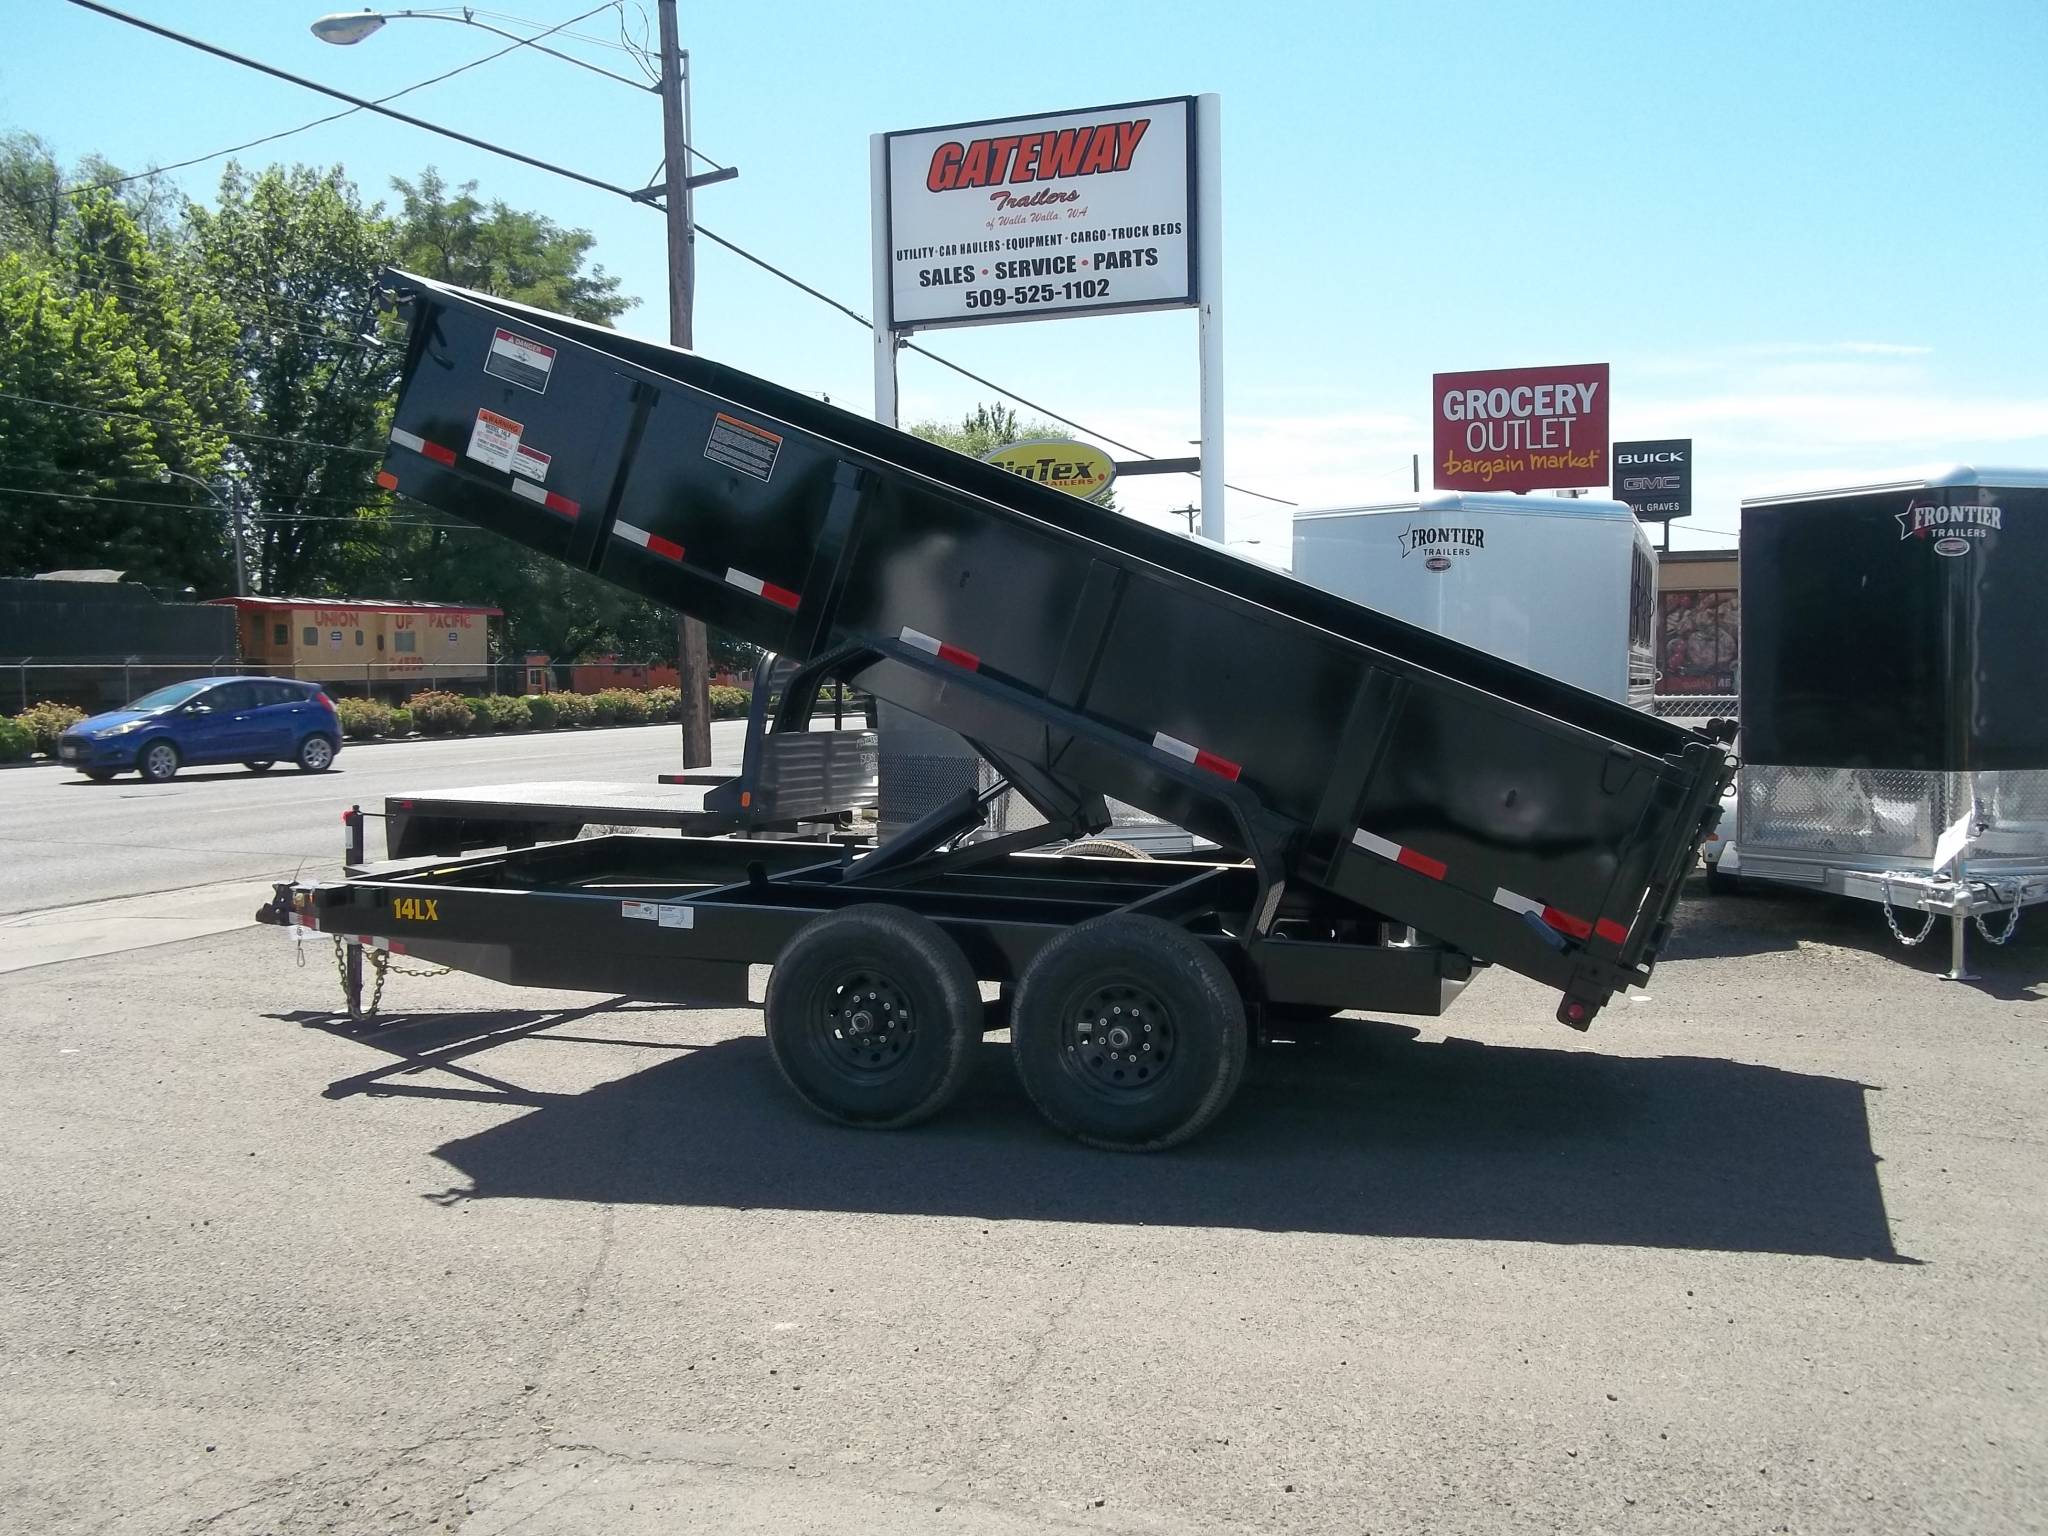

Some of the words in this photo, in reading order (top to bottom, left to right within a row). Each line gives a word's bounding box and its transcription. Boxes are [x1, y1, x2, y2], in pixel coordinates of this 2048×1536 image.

[926, 118, 1151, 193] GATEWAY
[990, 187, 1080, 211] Trailers
[986, 218, 995, 230] of
[998, 215, 1026, 226] Walla
[1067, 206, 1088, 218] WA
[896, 247, 934, 261] UTILITY
[939, 244, 957, 257] CAR
[960, 240, 1000, 255] HAULERS
[1006, 234, 1062, 250] EQUIPMENT
[1070, 229, 1106, 244] CARGO
[1111, 225, 1149, 240] TRUCK
[1152, 222, 1182, 236] BEDS
[919, 265, 976, 288] SALES
[995, 257, 1077, 280] SERVICE
[1093, 247, 1158, 271] PARTS
[965, 278, 1110, 309] 509-525-1102
[1443, 382, 1599, 421] GROCERY
[1466, 417, 1577, 452] OUTLET
[1443, 450, 1524, 482] bargain
[1530, 450, 1599, 470] market
[1618, 452, 1684, 464] BUICK
[1624, 476, 1680, 490] GMC
[1647, 502, 1680, 511] GRAVES
[1914, 506, 2001, 530] FRONTIER
[1412, 528, 1484, 549] FRONTIER
[1932, 528, 1987, 538] TRAILERS
[314, 611, 359, 627] UNION
[428, 613, 472, 629] PACIFIC
[394, 898, 438, 920] 14LX
